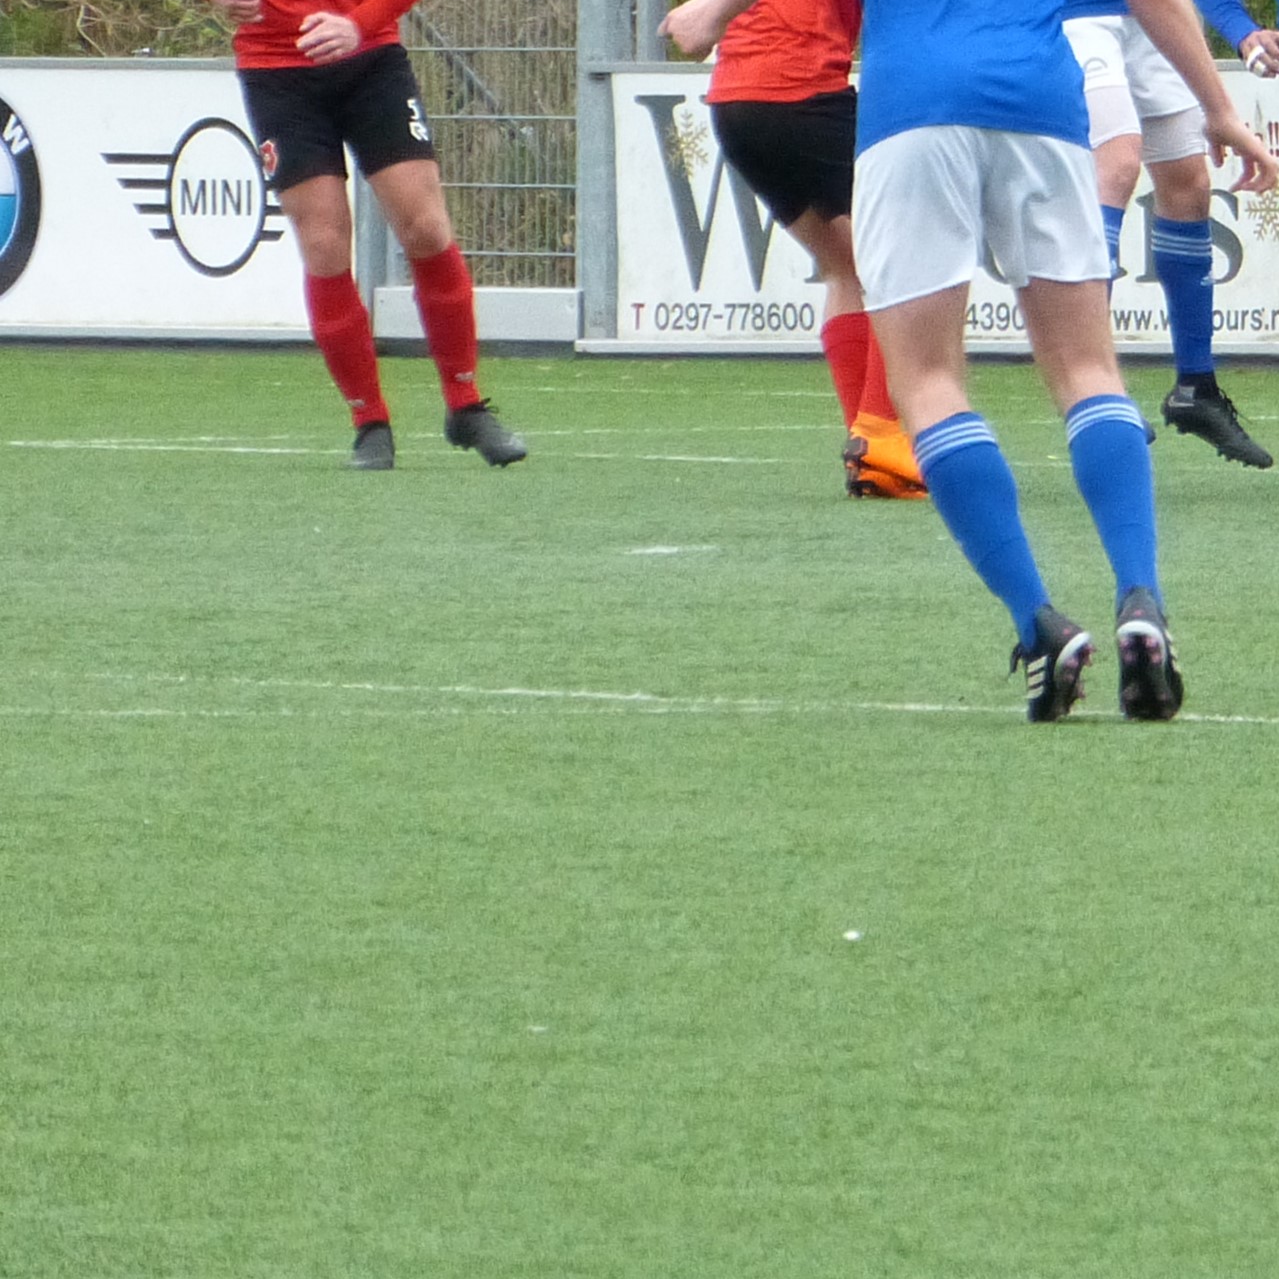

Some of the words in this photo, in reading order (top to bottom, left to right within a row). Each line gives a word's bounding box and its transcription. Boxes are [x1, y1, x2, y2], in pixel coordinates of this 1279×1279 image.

[180, 179, 252, 216] MINI
[632, 303, 645, 331] T
[654, 303, 815, 332] 0297-778600
